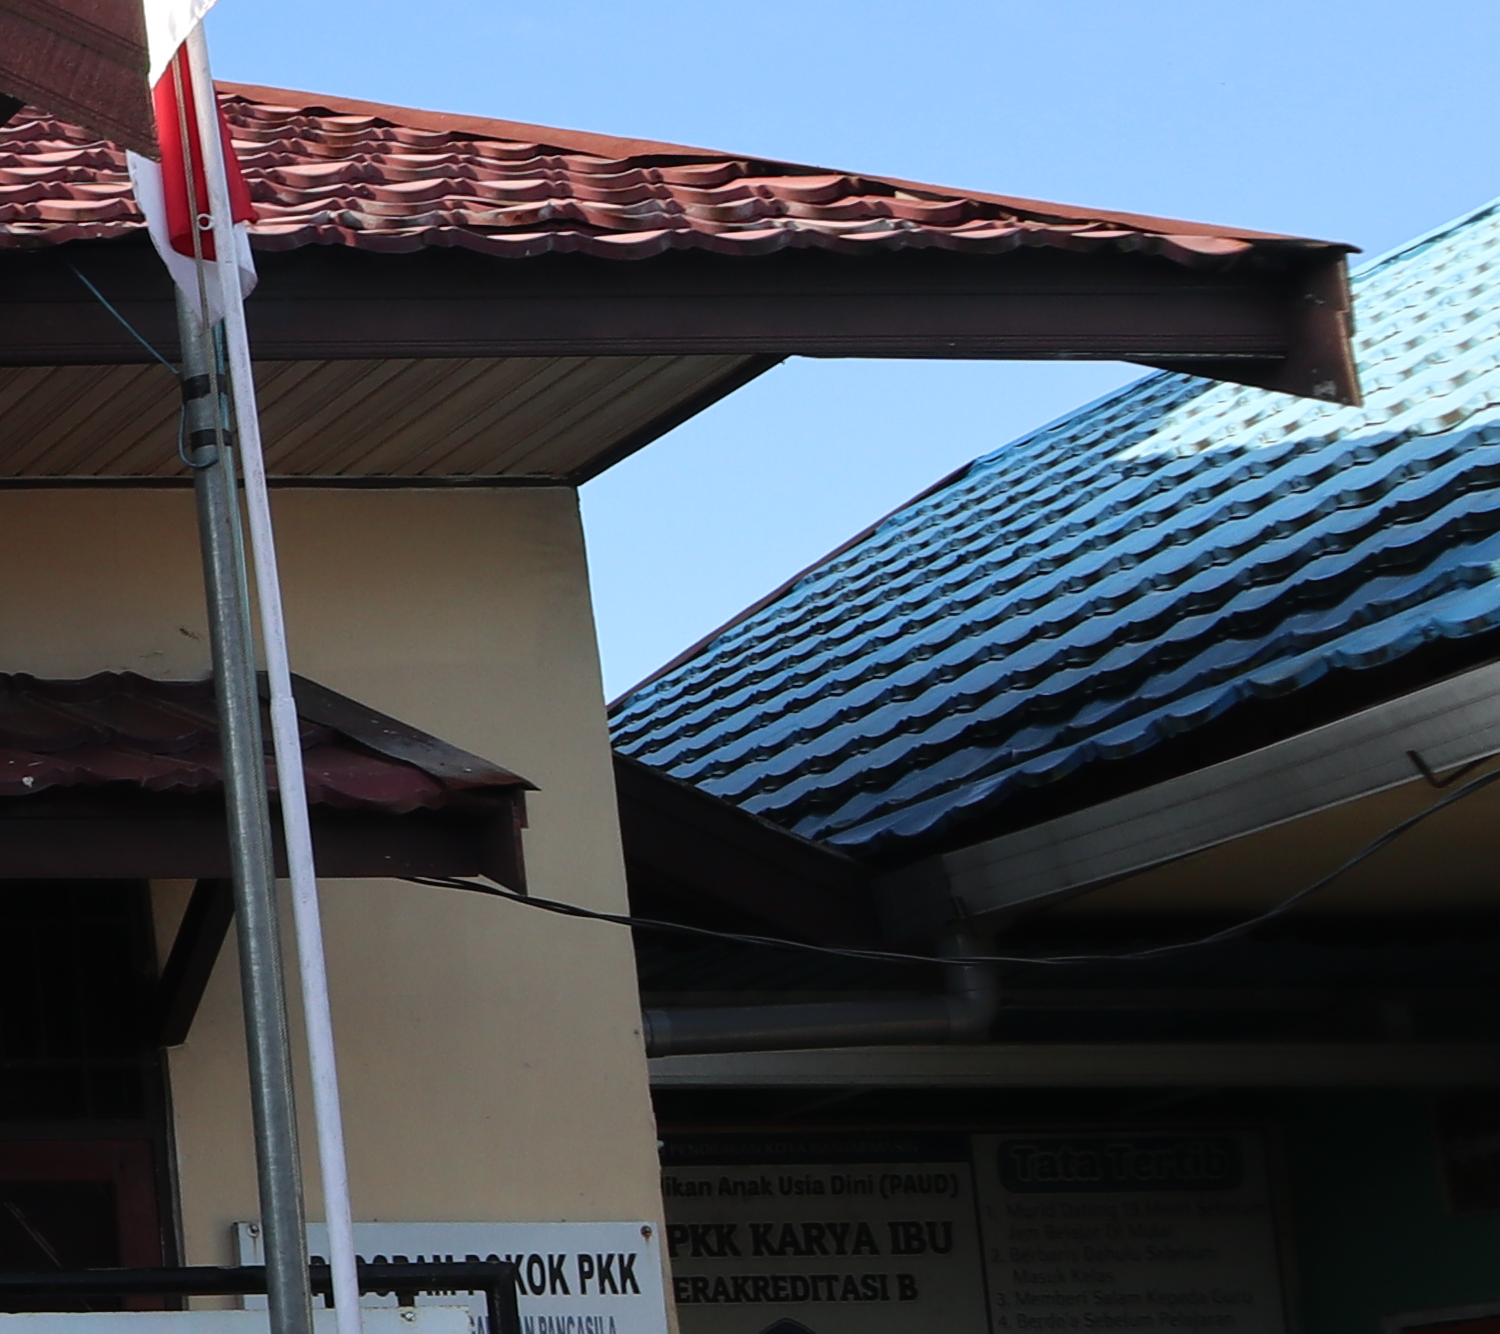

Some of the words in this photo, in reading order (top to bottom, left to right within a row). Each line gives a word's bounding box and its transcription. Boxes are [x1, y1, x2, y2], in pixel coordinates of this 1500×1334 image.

[1010, 1145, 1104, 1182] Tata
[1105, 1141, 1231, 1180] Tertib
[718, 1175, 774, 1197] Anak
[778, 1174, 825, 1196] Usia
[830, 1173, 874, 1195] Dini
[879, 1172, 959, 1200] (PAUD)
[666, 1222, 742, 1258] PKK
[748, 1221, 880, 1257] KARYA
[887, 1220, 954, 1256] IBU
[578, 1252, 641, 1296] PKK
[674, 1273, 891, 1304] ERAKREDITASI
[896, 1273, 919, 1302] B
